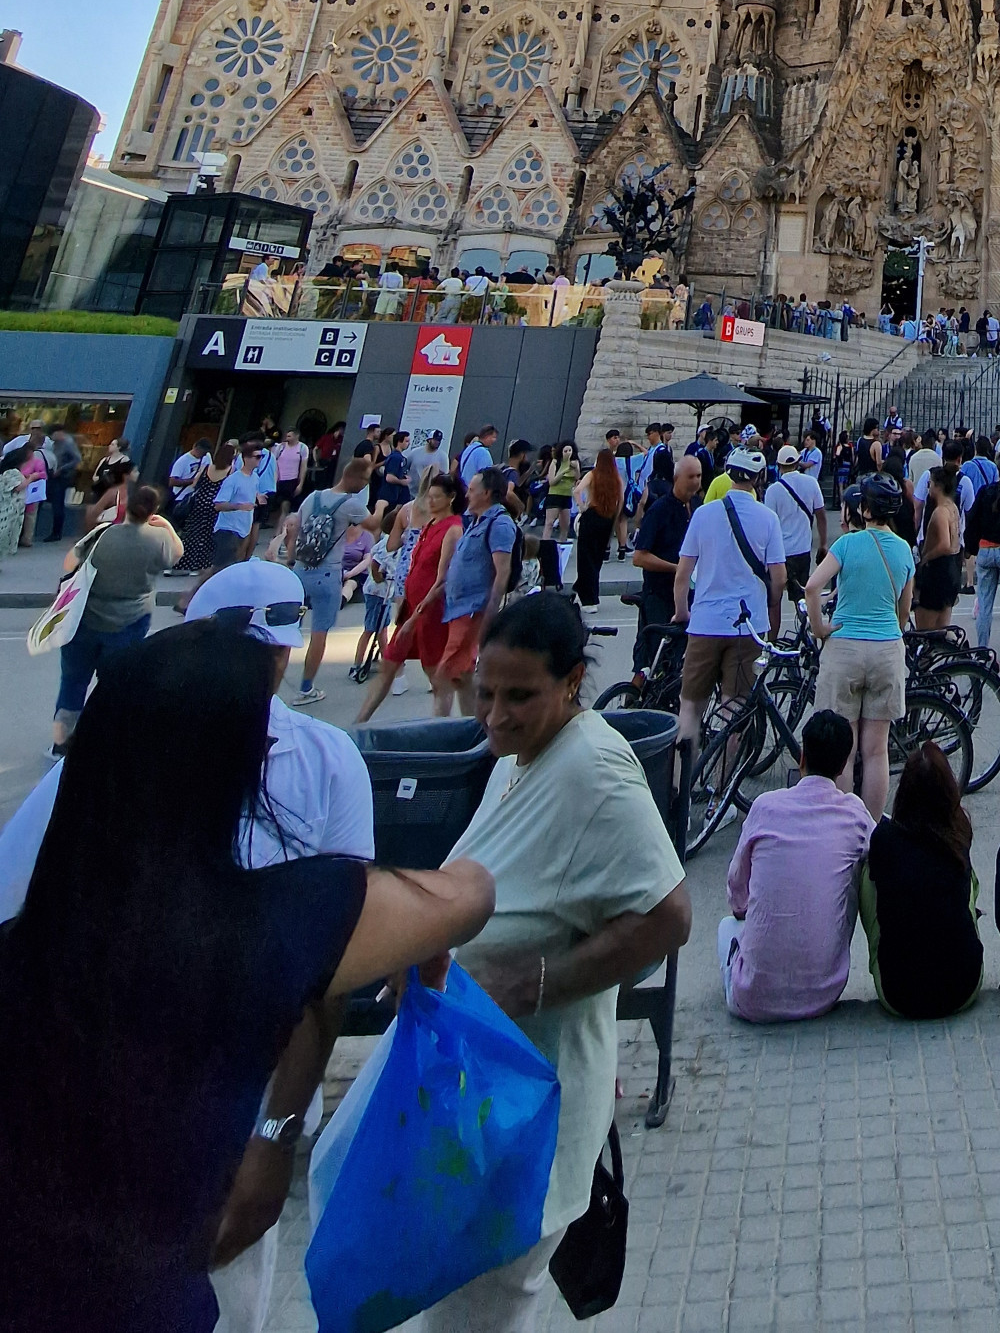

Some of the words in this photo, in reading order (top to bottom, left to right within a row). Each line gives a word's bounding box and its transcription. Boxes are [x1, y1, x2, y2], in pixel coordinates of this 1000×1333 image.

[725, 321, 732, 336] B
[735, 325, 754, 337] GRUPS
[325, 331, 334, 342] B
[201, 330, 226, 356] A
[320, 352, 330, 362] C
[341, 353, 350, 363] D
[413, 384, 444, 393] Tickets
